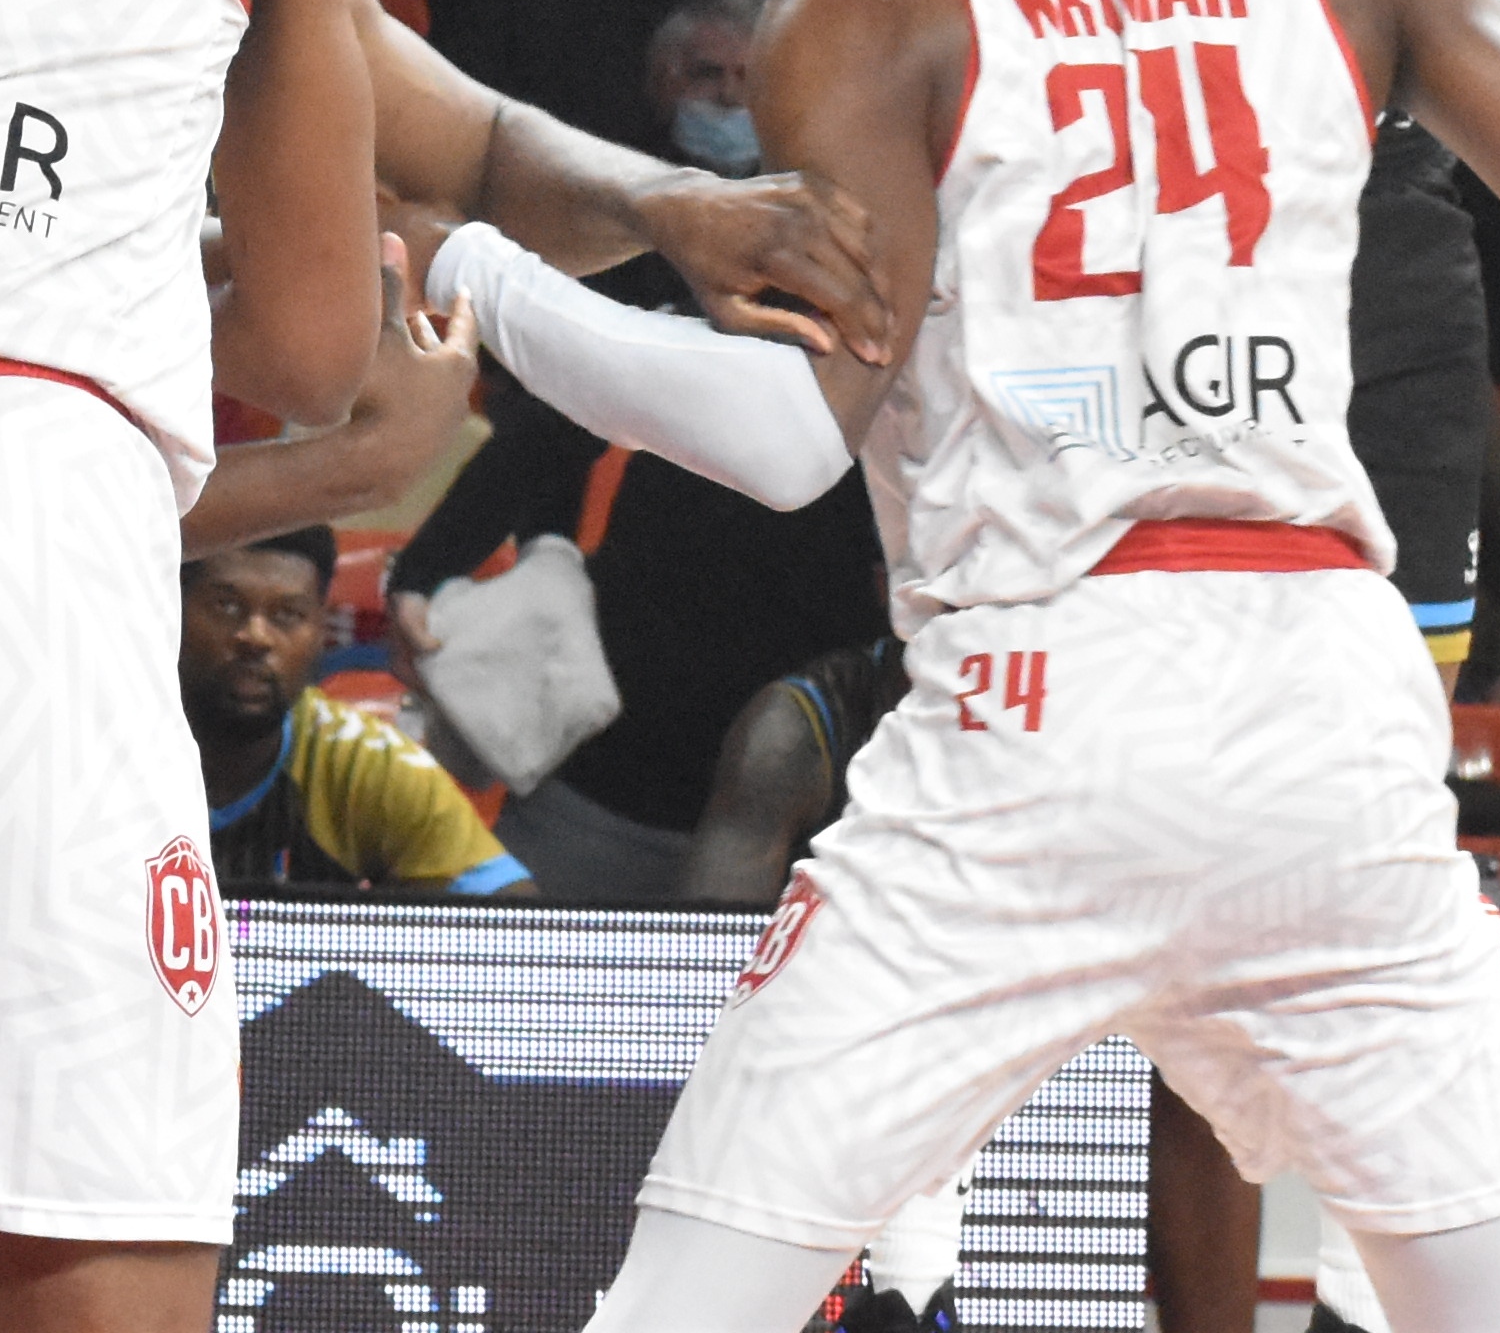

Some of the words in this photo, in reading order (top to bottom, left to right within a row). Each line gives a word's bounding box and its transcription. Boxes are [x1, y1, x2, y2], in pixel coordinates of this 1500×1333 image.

[1030, 41, 1272, 302] 24
[956, 651, 1048, 732] 24
[161, 875, 214, 972] CB
